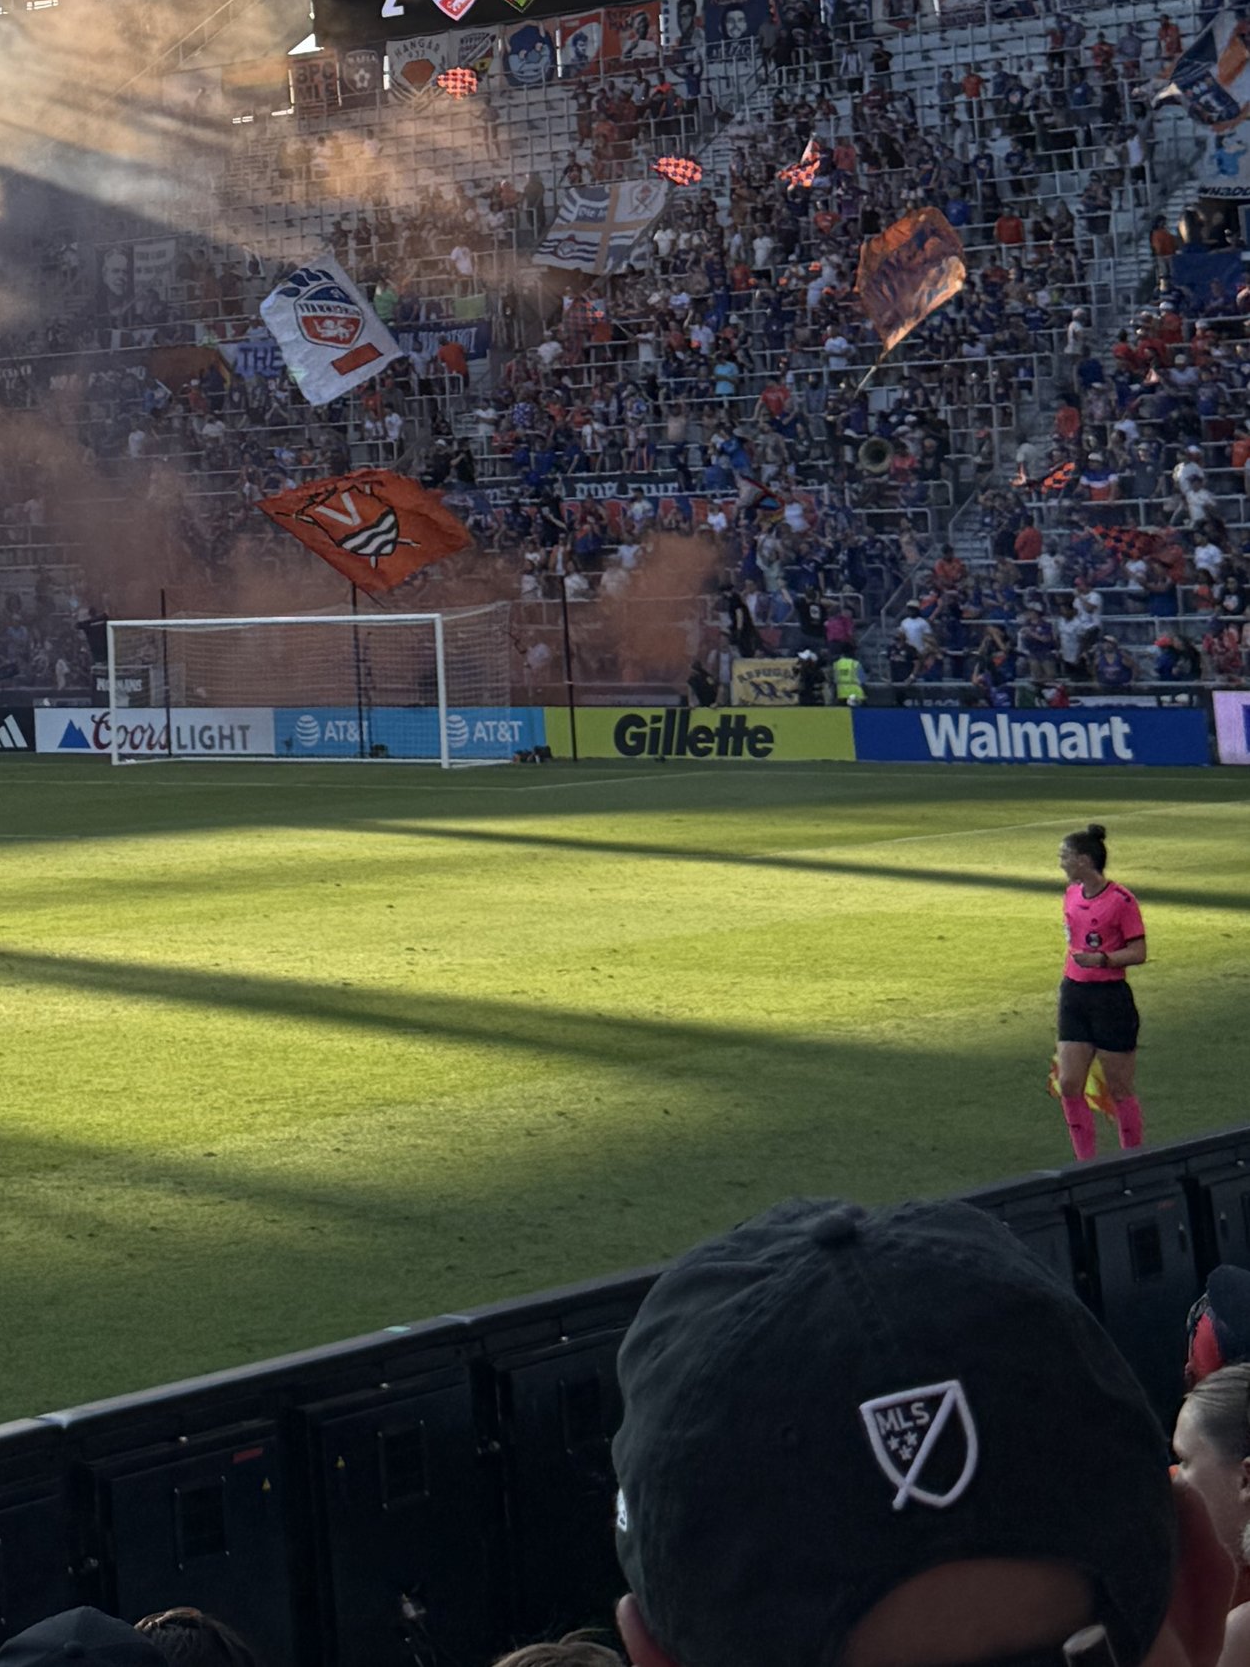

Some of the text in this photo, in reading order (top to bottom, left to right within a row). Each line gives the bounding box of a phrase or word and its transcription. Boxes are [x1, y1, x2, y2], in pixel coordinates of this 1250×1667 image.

[239, 345, 283, 371] THE
[176, 724, 251, 752] LIGHT
[324, 719, 369, 743] AT&T
[473, 719, 523, 743] AT&T
[614, 708, 775, 758] Gillette
[918, 712, 1134, 761] Walmart
[874, 1400, 930, 1438] MLS
